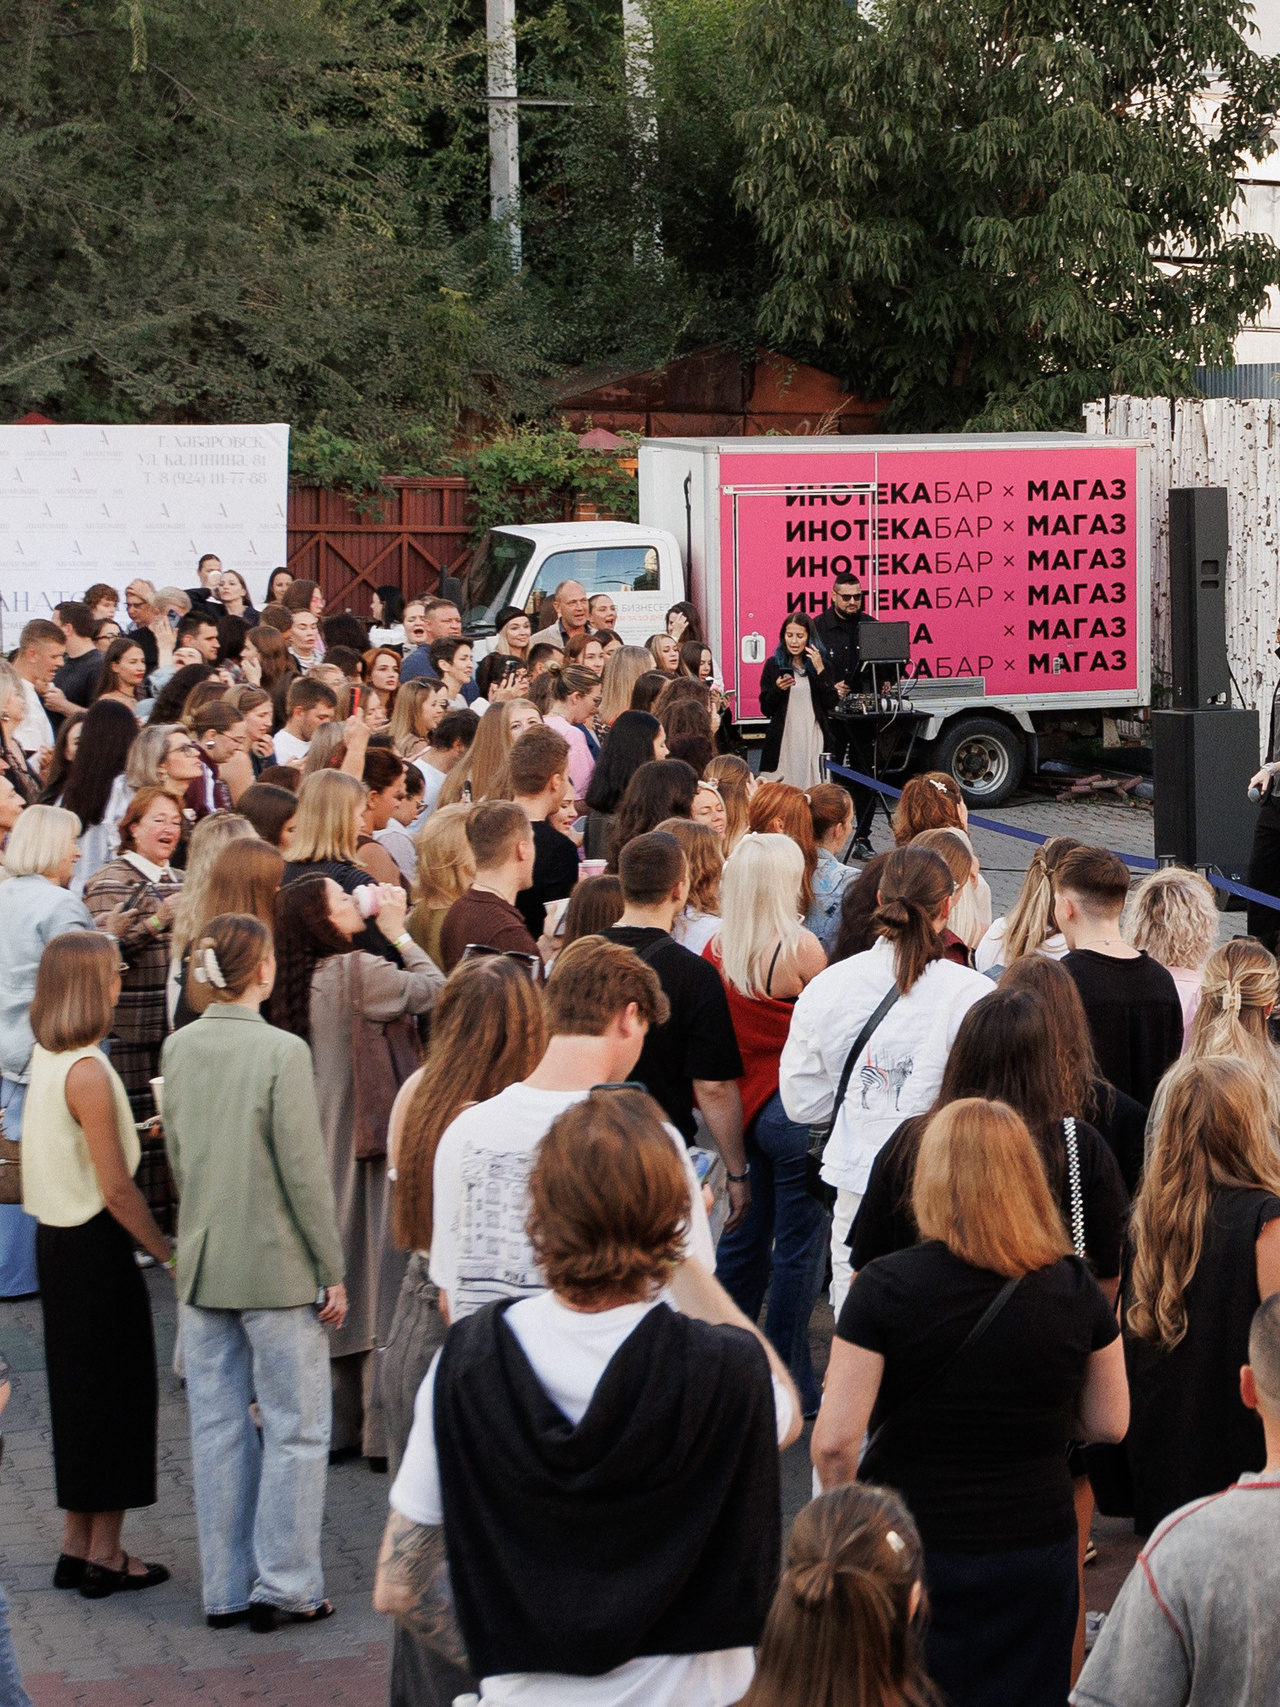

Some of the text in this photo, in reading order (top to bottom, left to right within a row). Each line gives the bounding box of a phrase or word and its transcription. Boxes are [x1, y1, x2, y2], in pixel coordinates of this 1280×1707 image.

[1027, 478, 1127, 502] МАГАЗ
[1027, 513, 1127, 537] МАГАЗ
[1027, 547, 1127, 572] МАГАЗ
[786, 585, 994, 614] ИНТЕКАБАР
[1027, 581, 1127, 607] МАГАЗ
[1028, 616, 1127, 641] МАГАЗ
[1028, 649, 1127, 675] МАГАЗ
